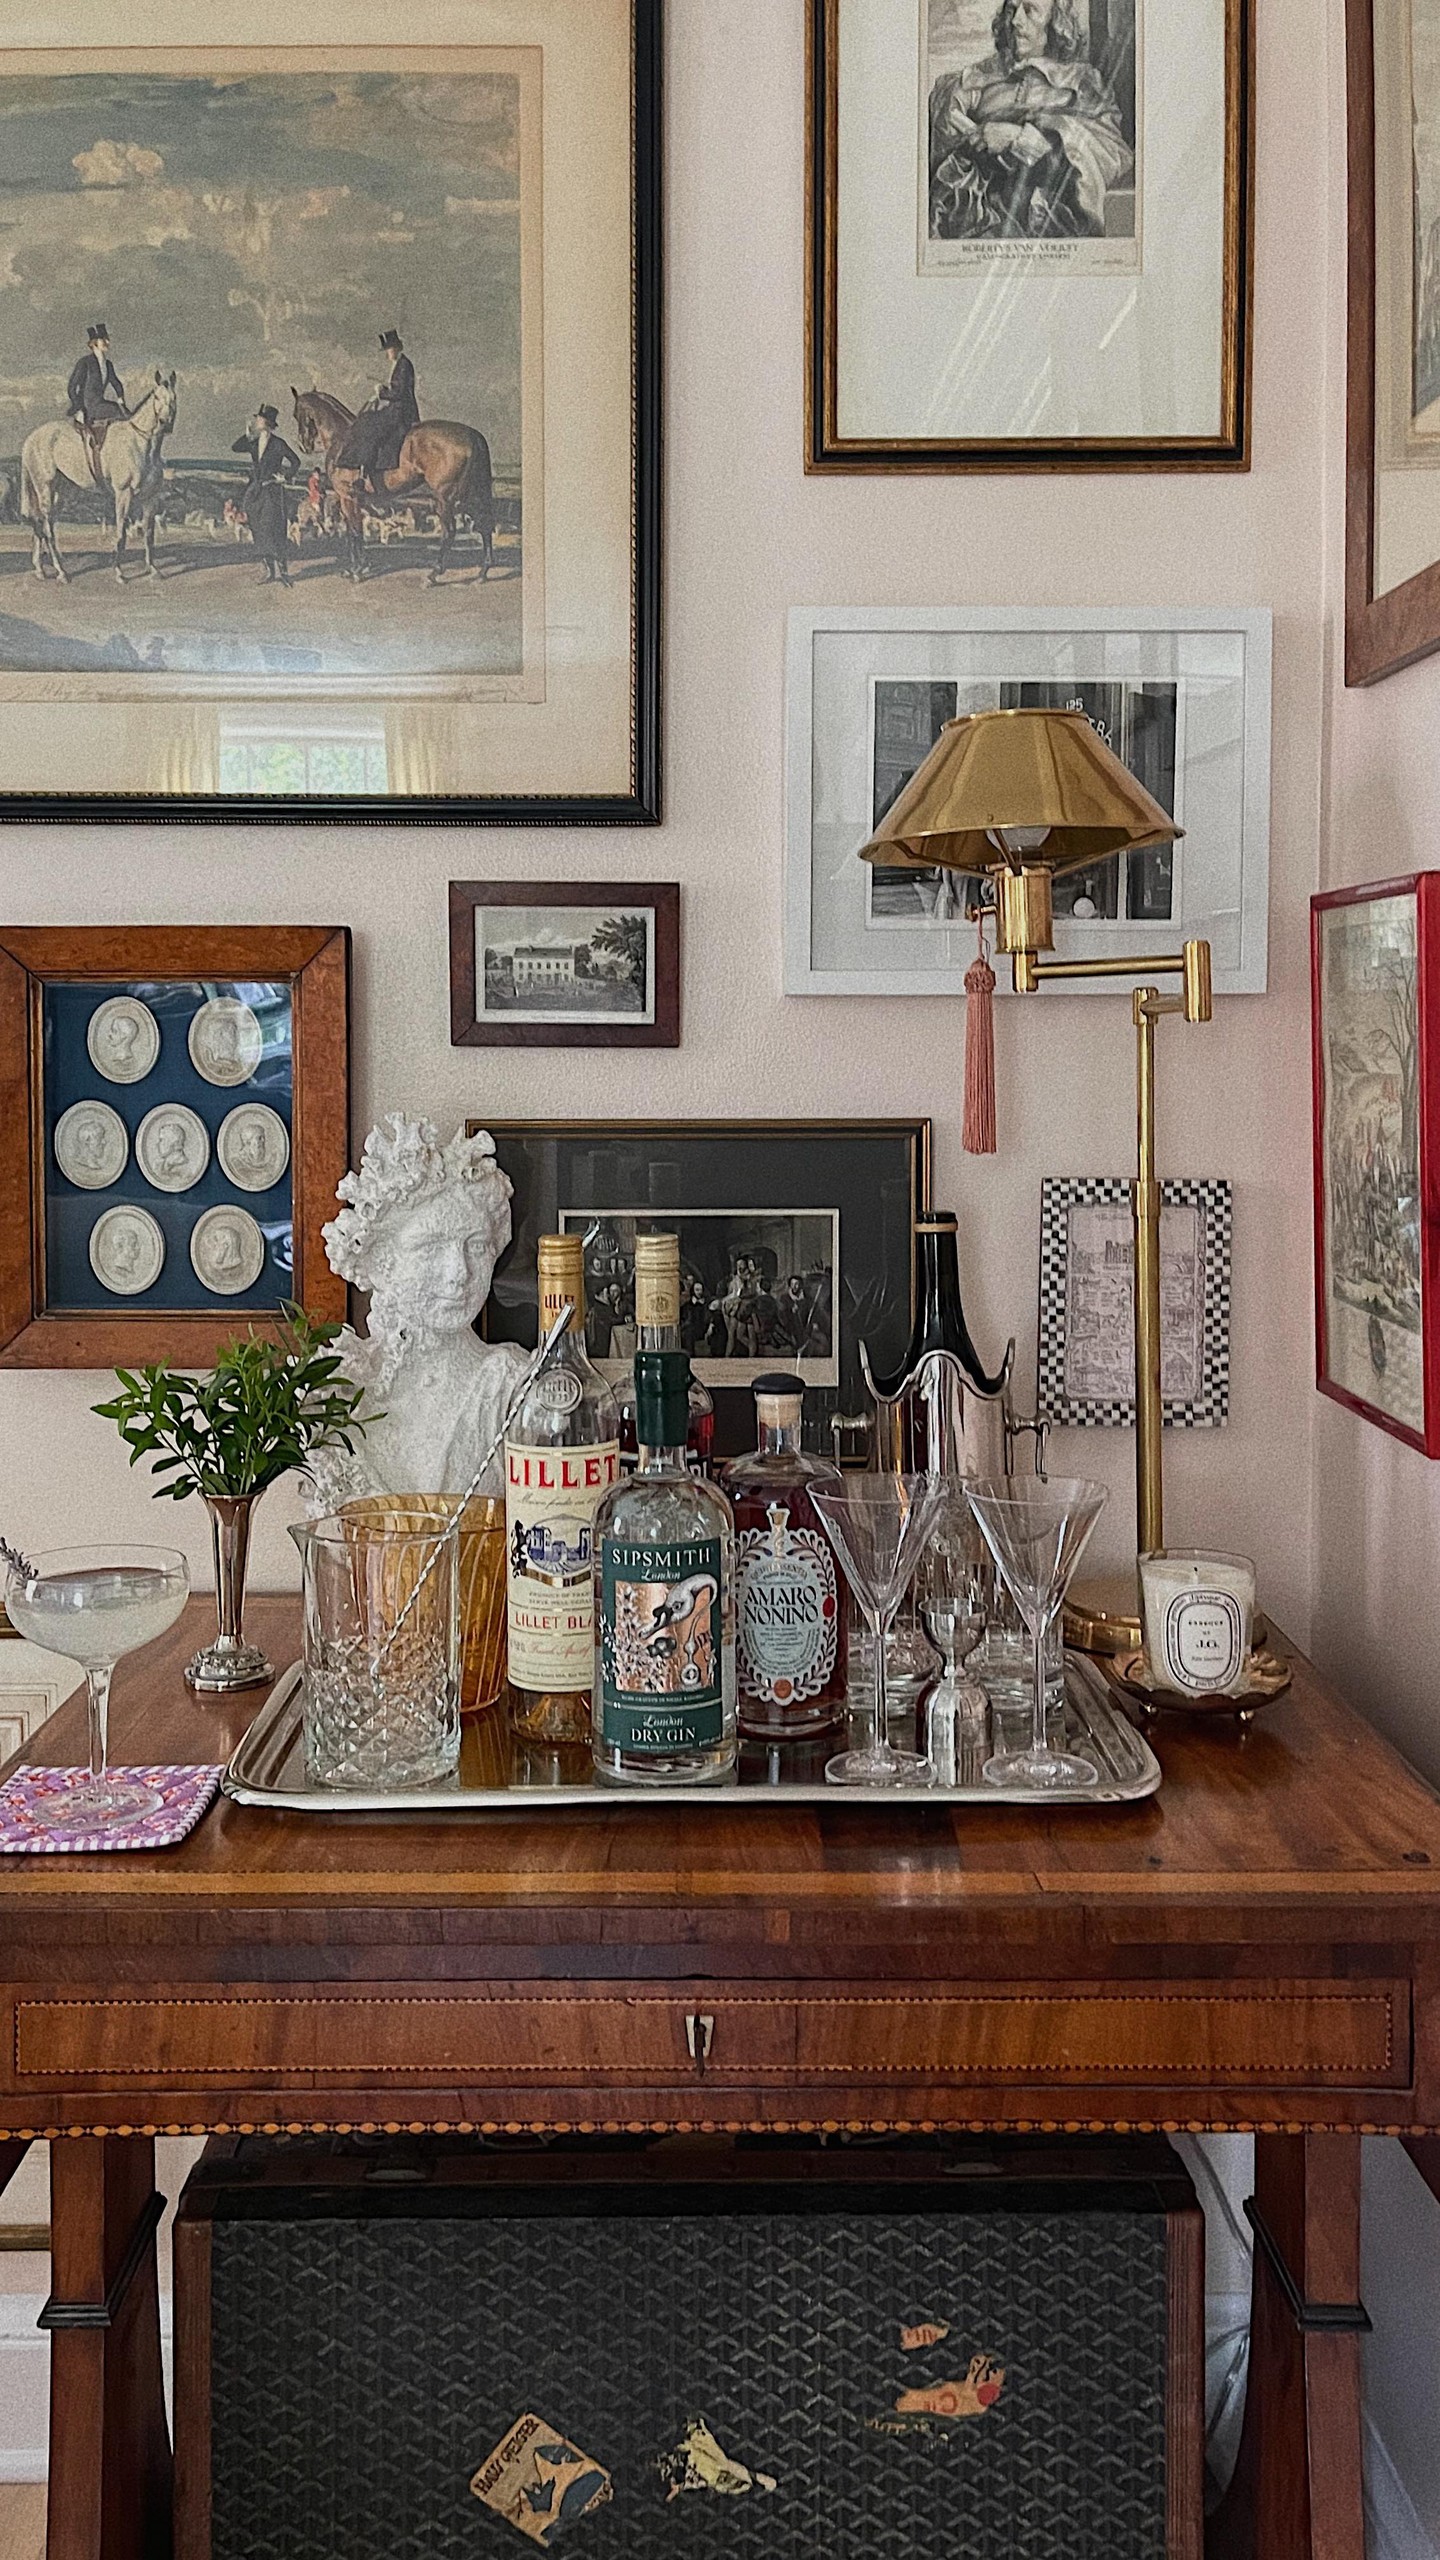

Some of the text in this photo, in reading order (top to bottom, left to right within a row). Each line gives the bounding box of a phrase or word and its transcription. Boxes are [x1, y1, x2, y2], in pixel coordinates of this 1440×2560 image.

[508, 1454, 616, 1488] LILLET
[612, 1547, 710, 1568] SIPSMITH
[641, 1569, 680, 1582] London
[744, 1585, 817, 1606] AMARO
[516, 1611, 560, 1630] LILLET
[744, 1604, 819, 1626] NONINO
[643, 1714, 683, 1728] London
[631, 1728, 663, 1743] DRY
[666, 1727, 696, 1742] GIN
